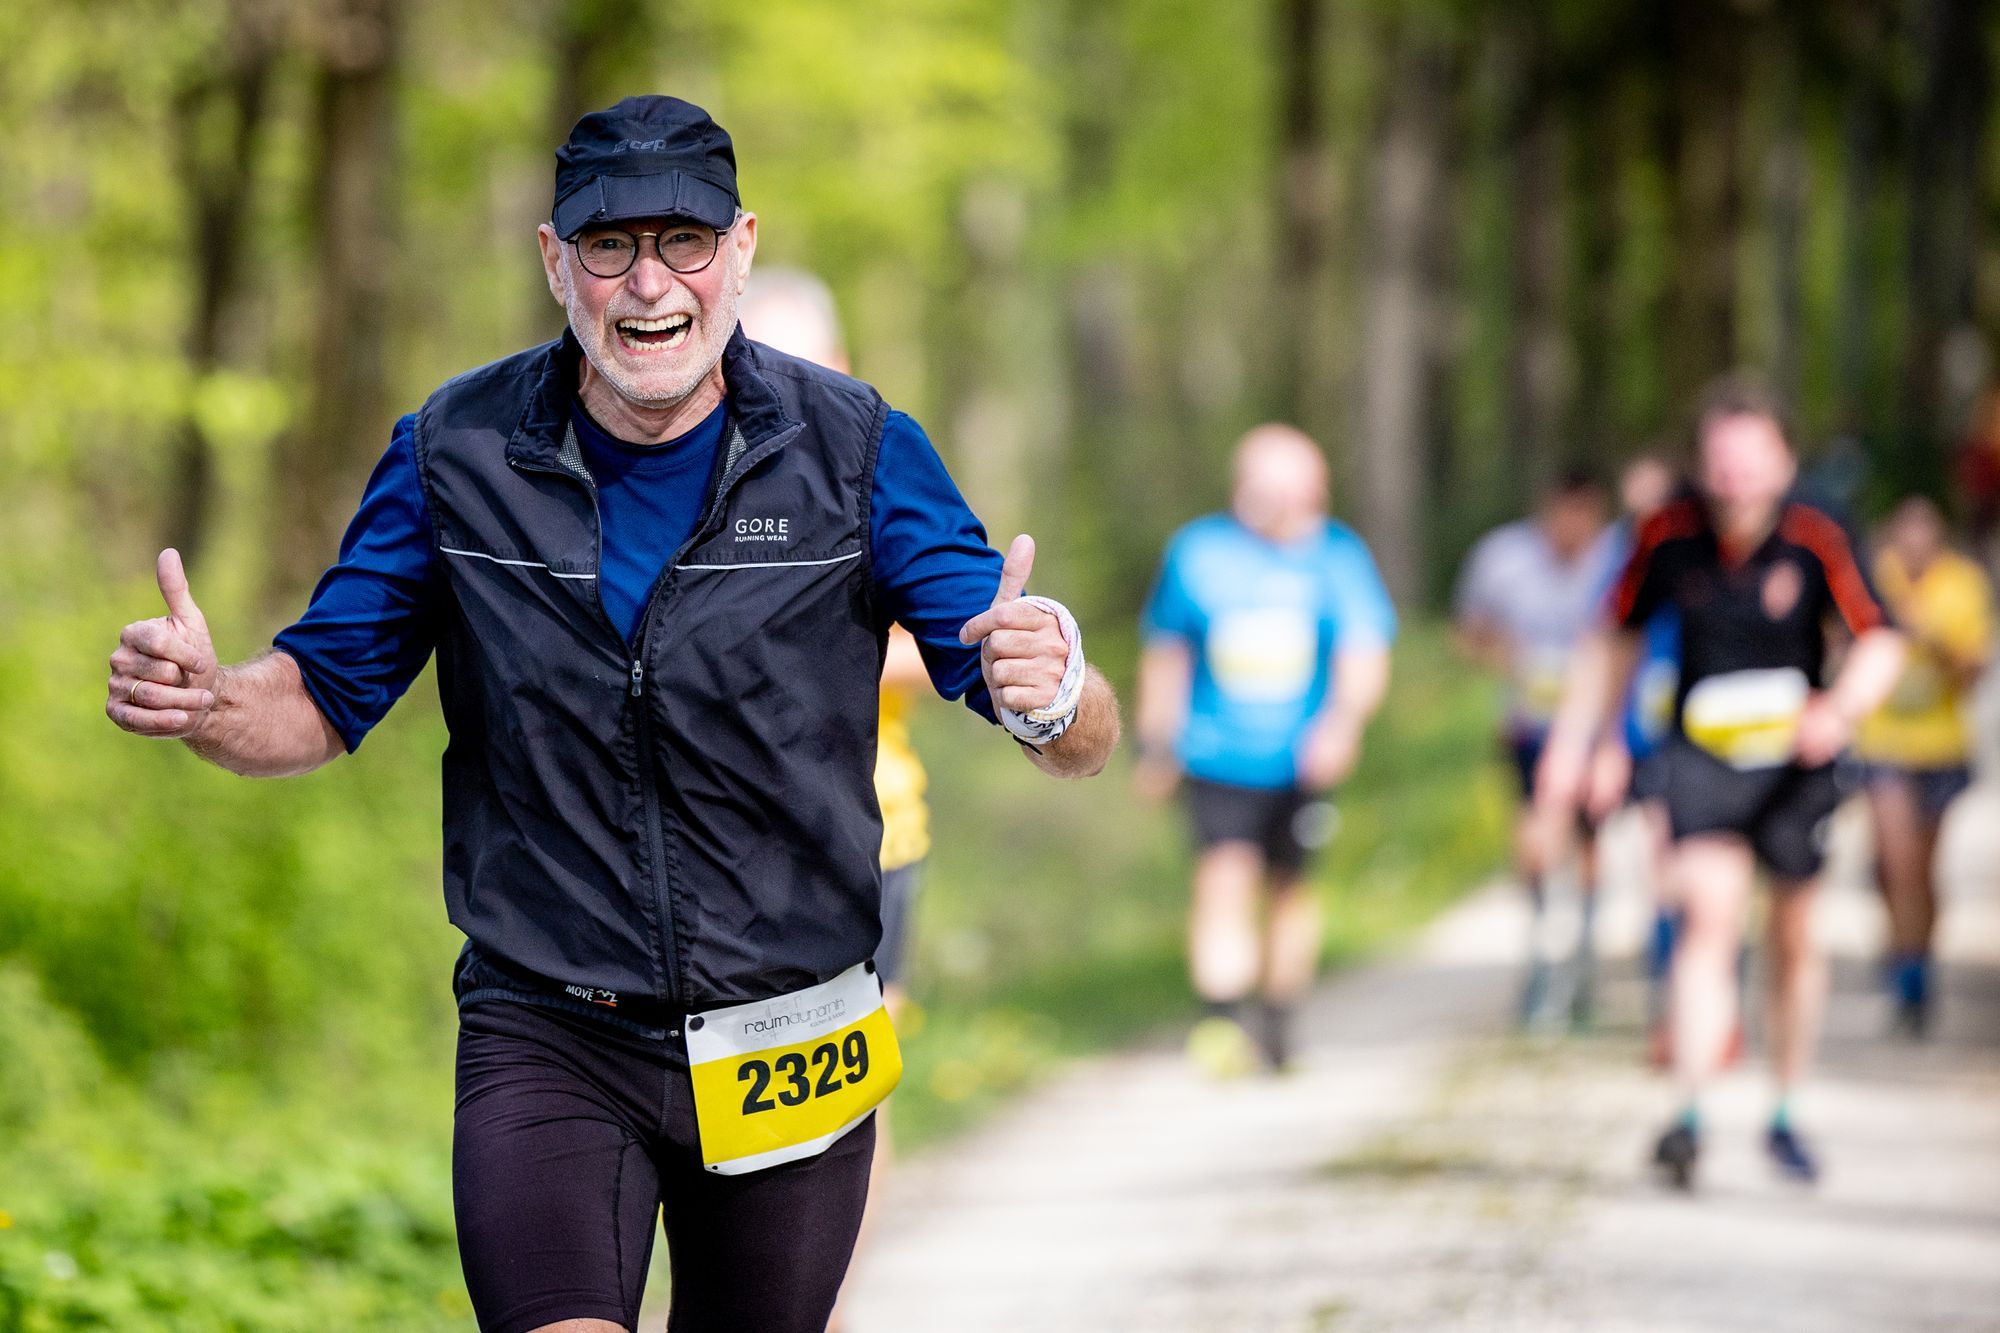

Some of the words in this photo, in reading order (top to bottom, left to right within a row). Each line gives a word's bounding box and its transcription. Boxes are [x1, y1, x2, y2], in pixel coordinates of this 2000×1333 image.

[735, 518, 789, 534] GORE
[734, 534, 765, 543] RUNNING
[737, 1030, 869, 1116] 2329
